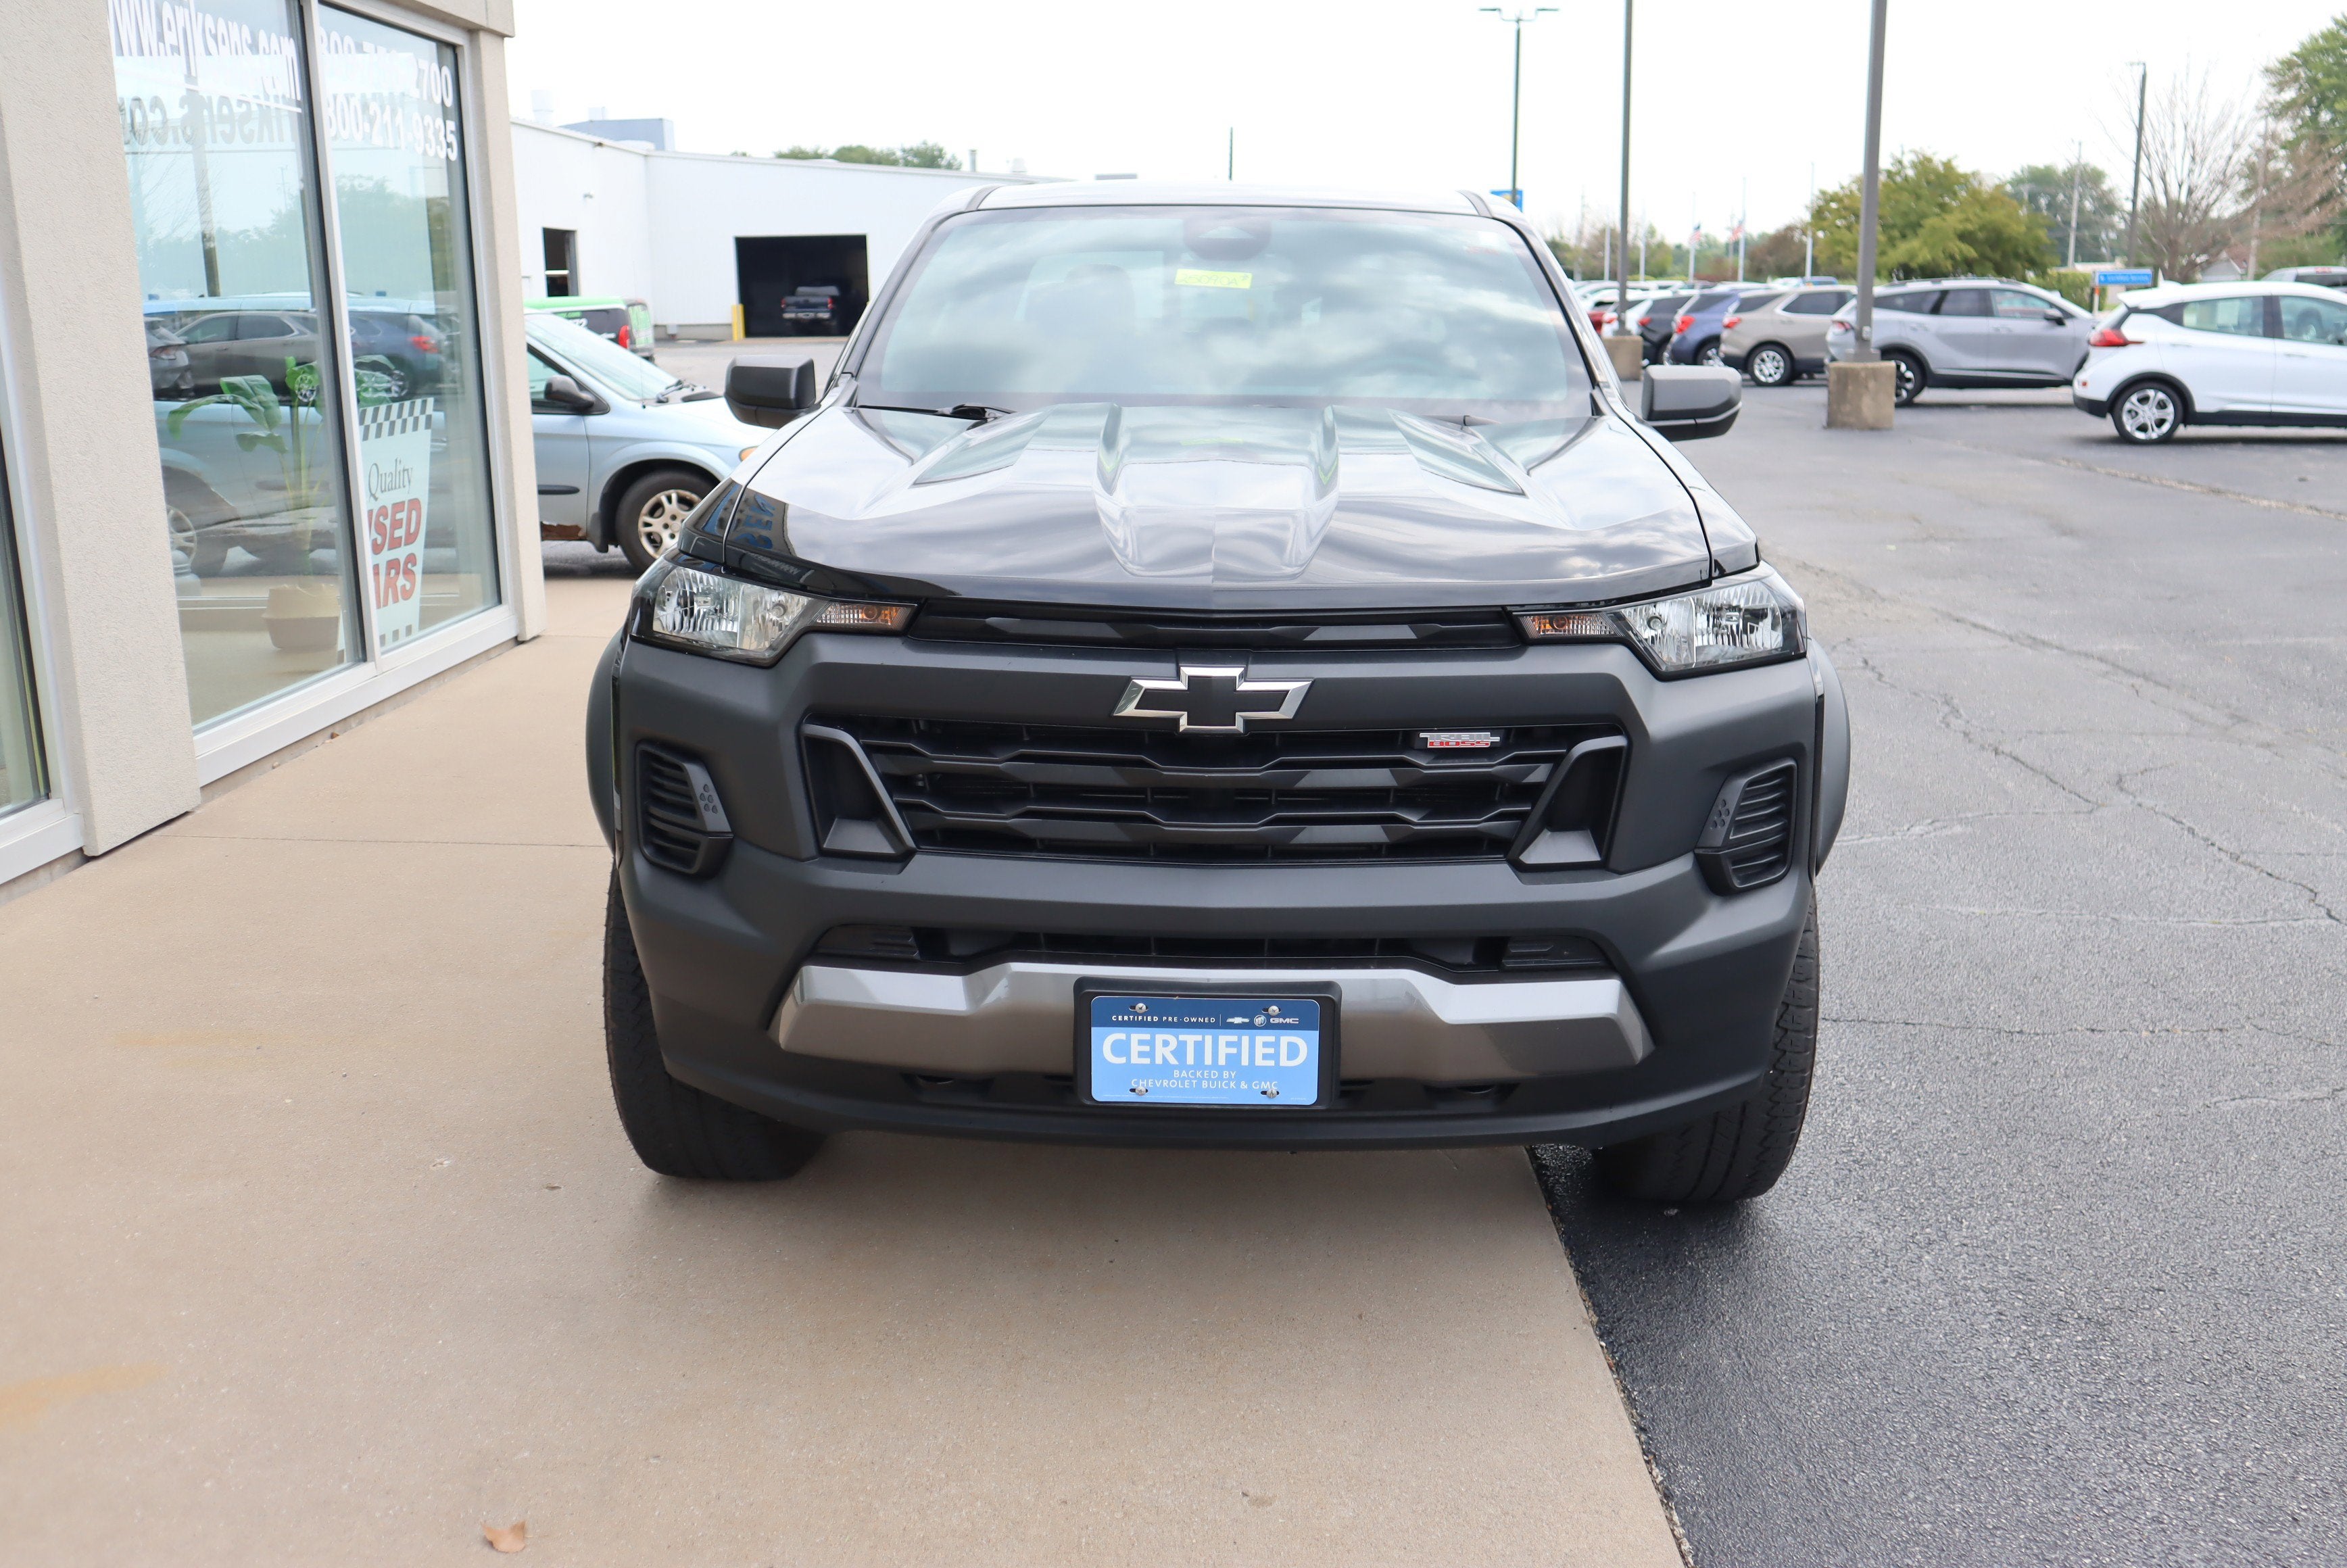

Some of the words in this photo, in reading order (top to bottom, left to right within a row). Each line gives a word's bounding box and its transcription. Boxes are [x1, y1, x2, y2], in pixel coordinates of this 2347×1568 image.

[368, 458, 413, 501] Quality
[368, 497, 422, 556] SED
[1102, 1033, 1308, 1067] CERTIFIED
[1131, 1079, 1196, 1089] CHEVROLET
[1202, 1080, 1238, 1089] BUICK
[1240, 1081, 1248, 1089] &
[1252, 1081, 1278, 1090] GMC
[1174, 1070, 1219, 1079] BACKED
[1223, 1071, 1236, 1079] BY
